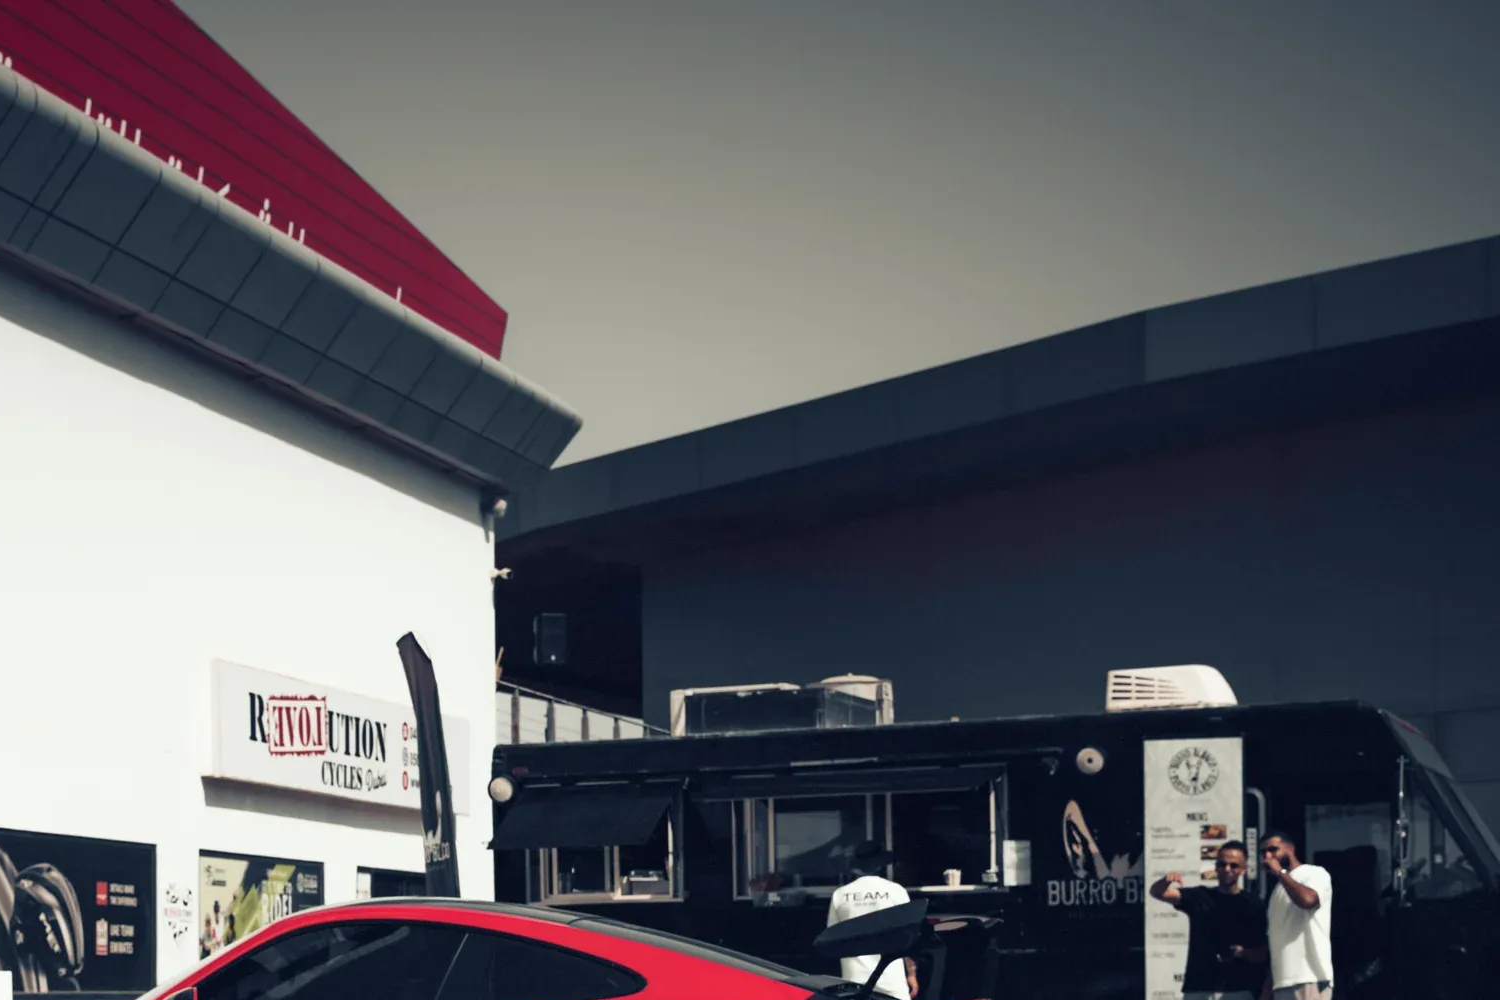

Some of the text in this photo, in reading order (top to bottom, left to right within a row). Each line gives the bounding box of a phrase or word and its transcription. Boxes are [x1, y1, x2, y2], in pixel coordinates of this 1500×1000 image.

[321, 760, 363, 790] CYCLES
[843, 891, 889, 902] TEAM
[1046, 878, 1117, 906] BURRO
